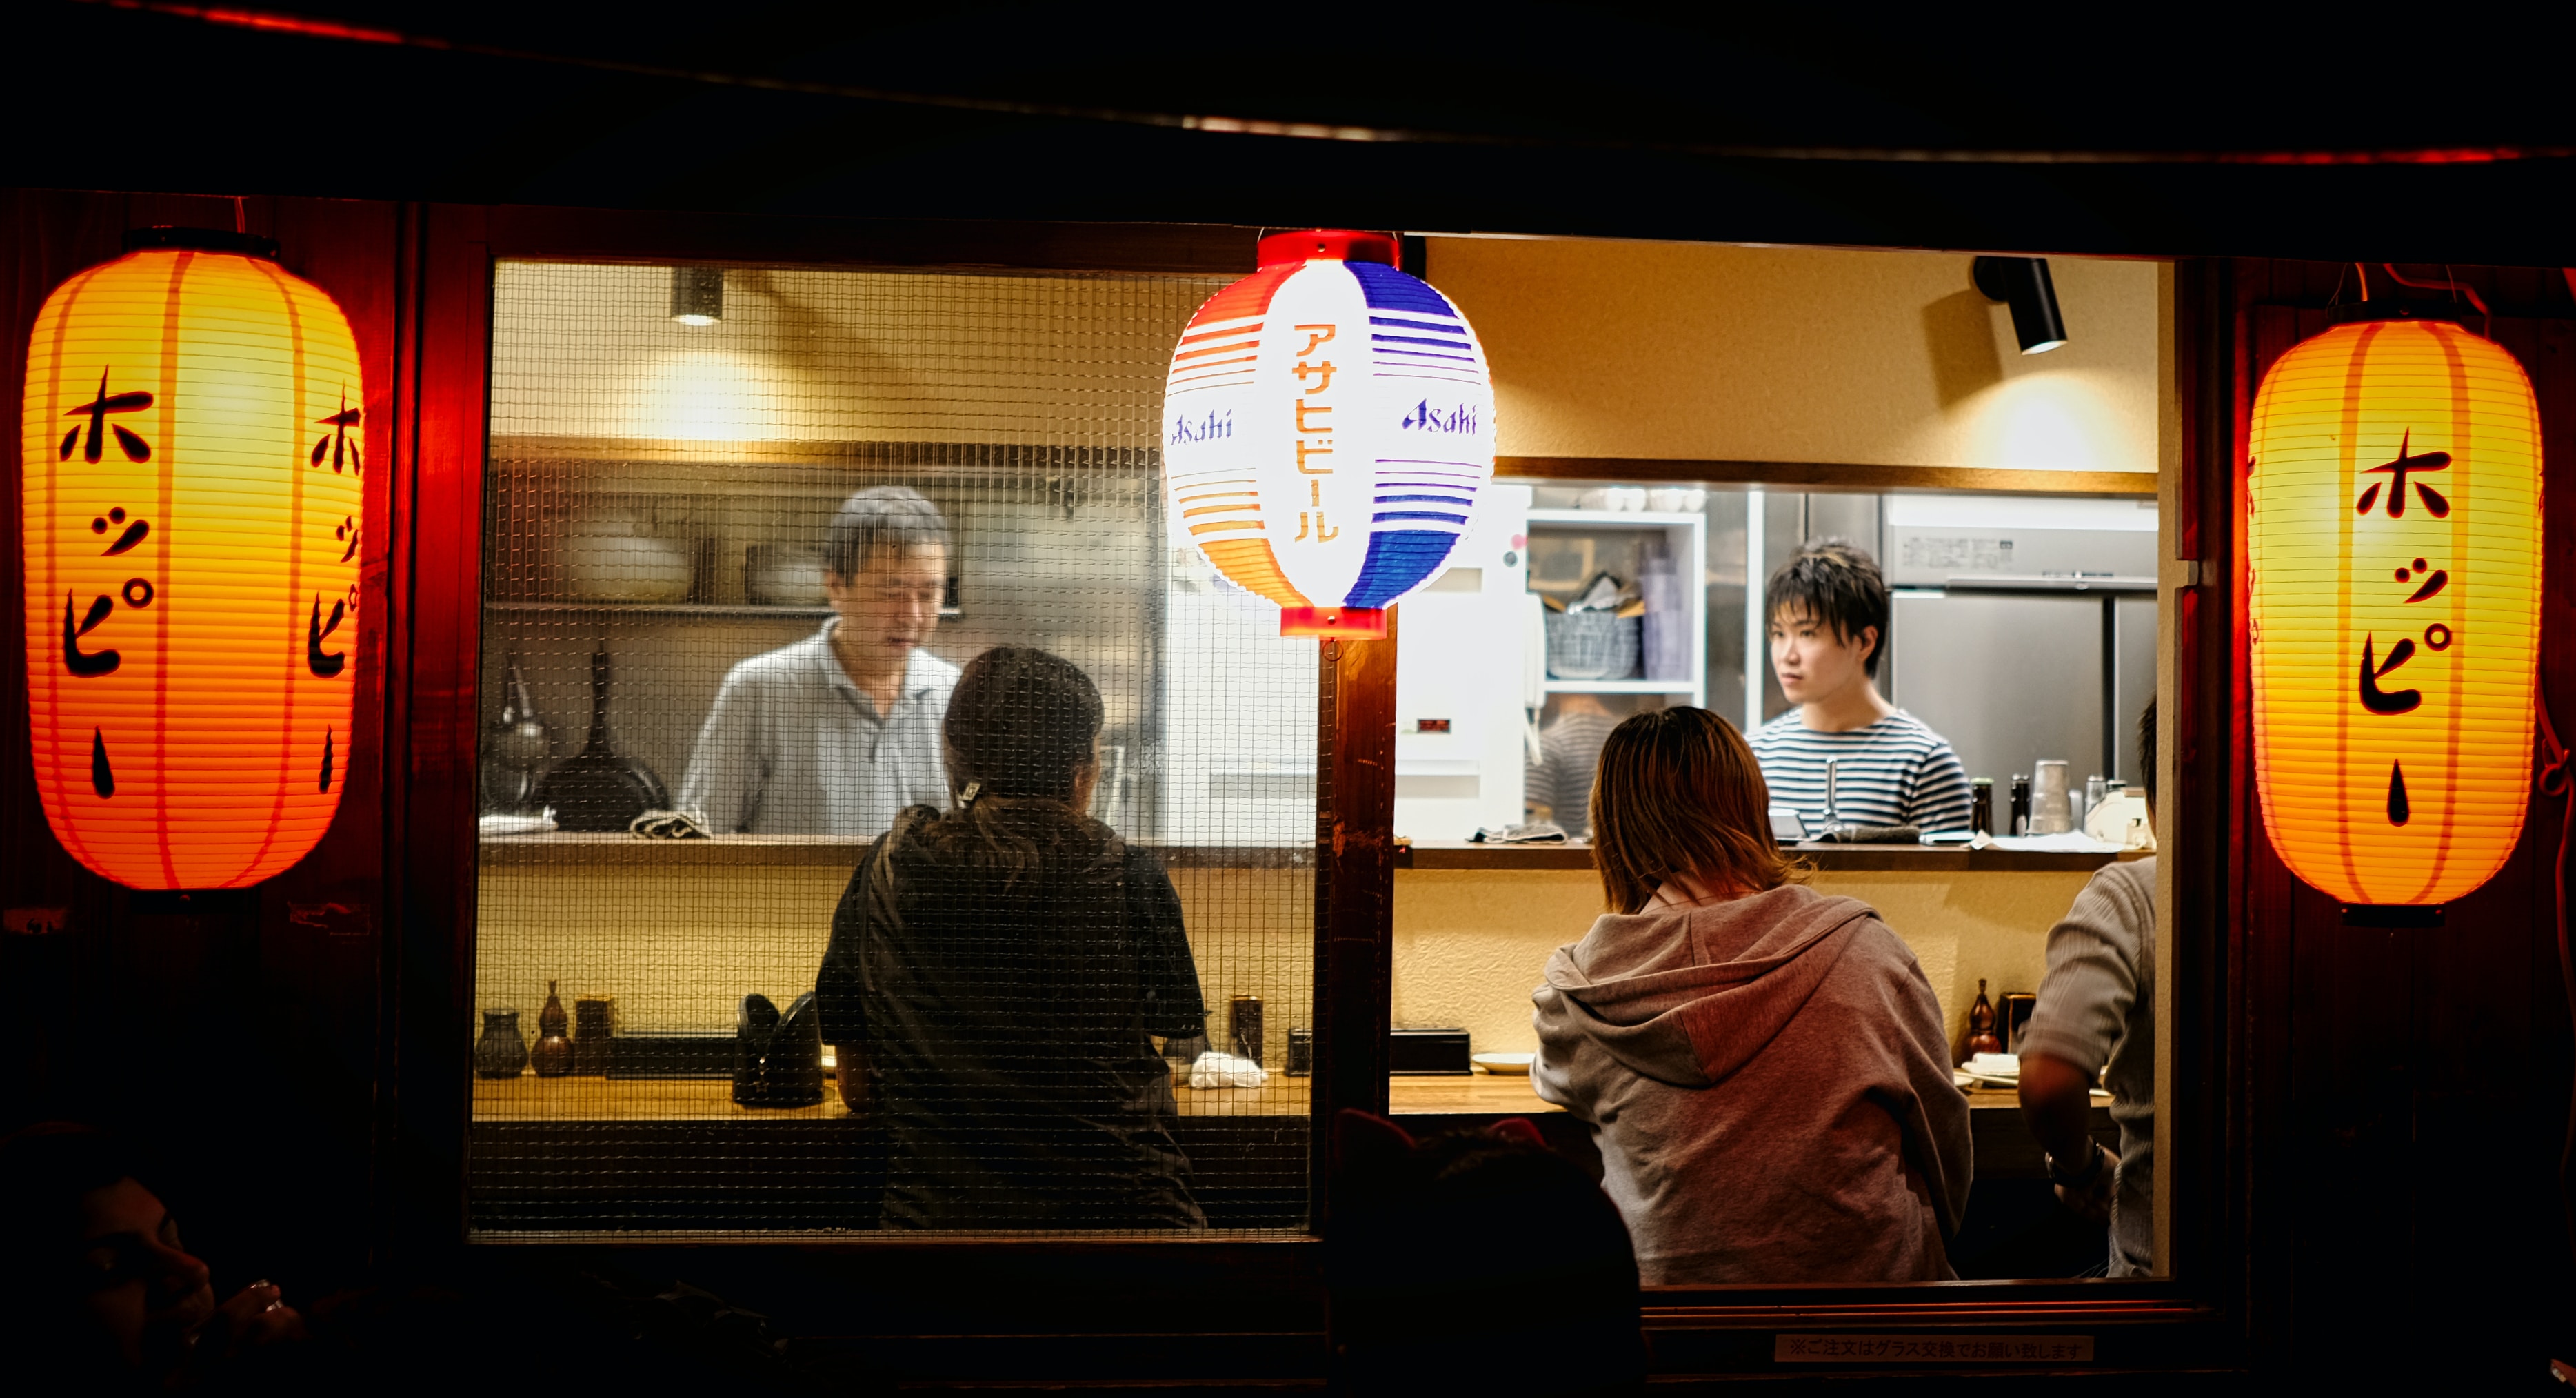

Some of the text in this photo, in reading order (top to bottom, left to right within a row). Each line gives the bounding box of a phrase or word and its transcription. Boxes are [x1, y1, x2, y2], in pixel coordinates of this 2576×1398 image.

[1170, 408, 1233, 447] Asahi
[1291, 323, 1338, 543] アサヒビール
[1401, 398, 1478, 436] Asahi
[59, 363, 154, 798] ホッピー
[2356, 426, 2452, 827] ホッピー
